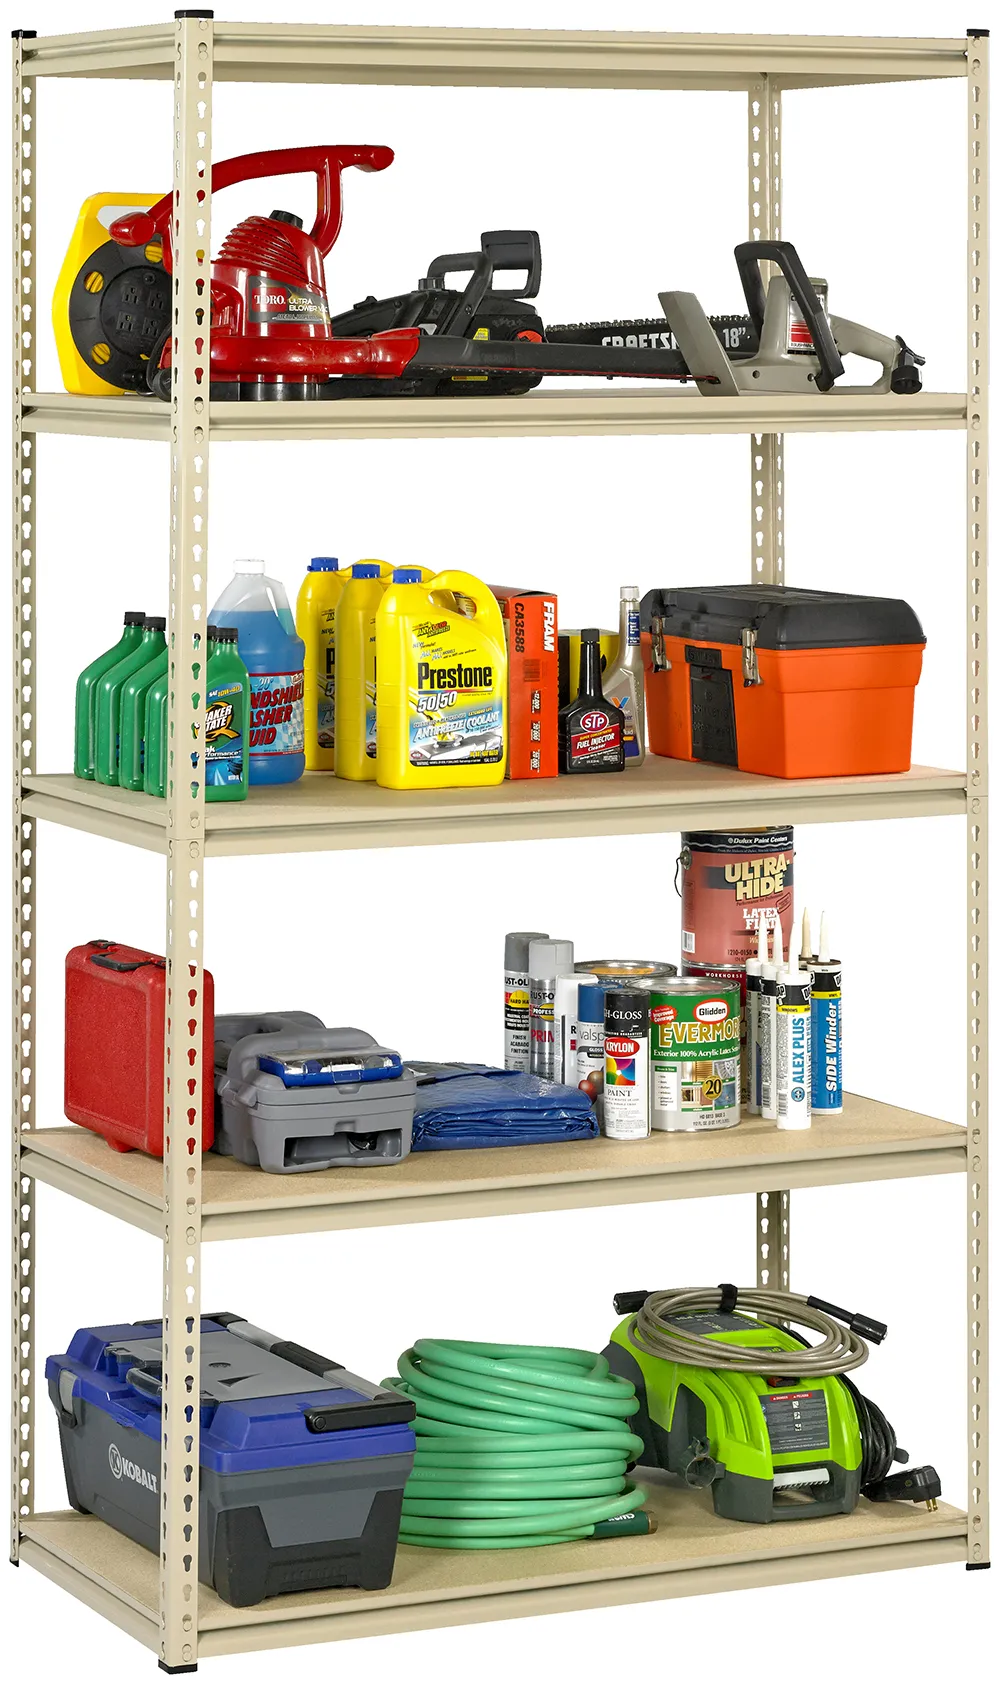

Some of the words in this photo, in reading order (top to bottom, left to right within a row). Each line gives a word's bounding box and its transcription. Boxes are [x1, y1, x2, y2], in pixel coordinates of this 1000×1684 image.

[601, 332, 680, 350] CRAFTS
[514, 602, 525, 653] CA3588
[543, 601, 555, 653] FRAM
[418, 662, 494, 690] Prestone
[416, 691, 459, 713] 50/50
[206, 704, 233, 722] AKER
[249, 704, 293, 729] SHER
[584, 713, 606, 729] STP
[249, 727, 277, 748] UID
[576, 739, 590, 750] FUEL
[590, 732, 616, 746] INJECTOR
[754, 836, 770, 844] Paint
[724, 852, 791, 884] ULTRA-
[735, 872, 785, 902] HIDE
[742, 906, 779, 919] LATEX
[745, 918, 776, 931] FLT
[530, 990, 555, 1001] RUST-O
[698, 1007, 727, 1017] Glidden
[579, 1028, 605, 1045] valsp
[658, 1015, 741, 1048] EVERMOR
[792, 1017, 805, 1049] PLUS
[824, 1002, 837, 1056] Winder
[606, 1041, 635, 1053] KRYLON
[653, 1049, 679, 1058] Exterior
[680, 1050, 697, 1058] 100%
[698, 1048, 719, 1058] Acrylic
[792, 1050, 805, 1084] ALEX
[825, 1056, 837, 1092] SIDE
[607, 1089, 633, 1097] PAINT
[705, 1078, 722, 1096] 20
[121, 1456, 158, 1494] KOBALT
